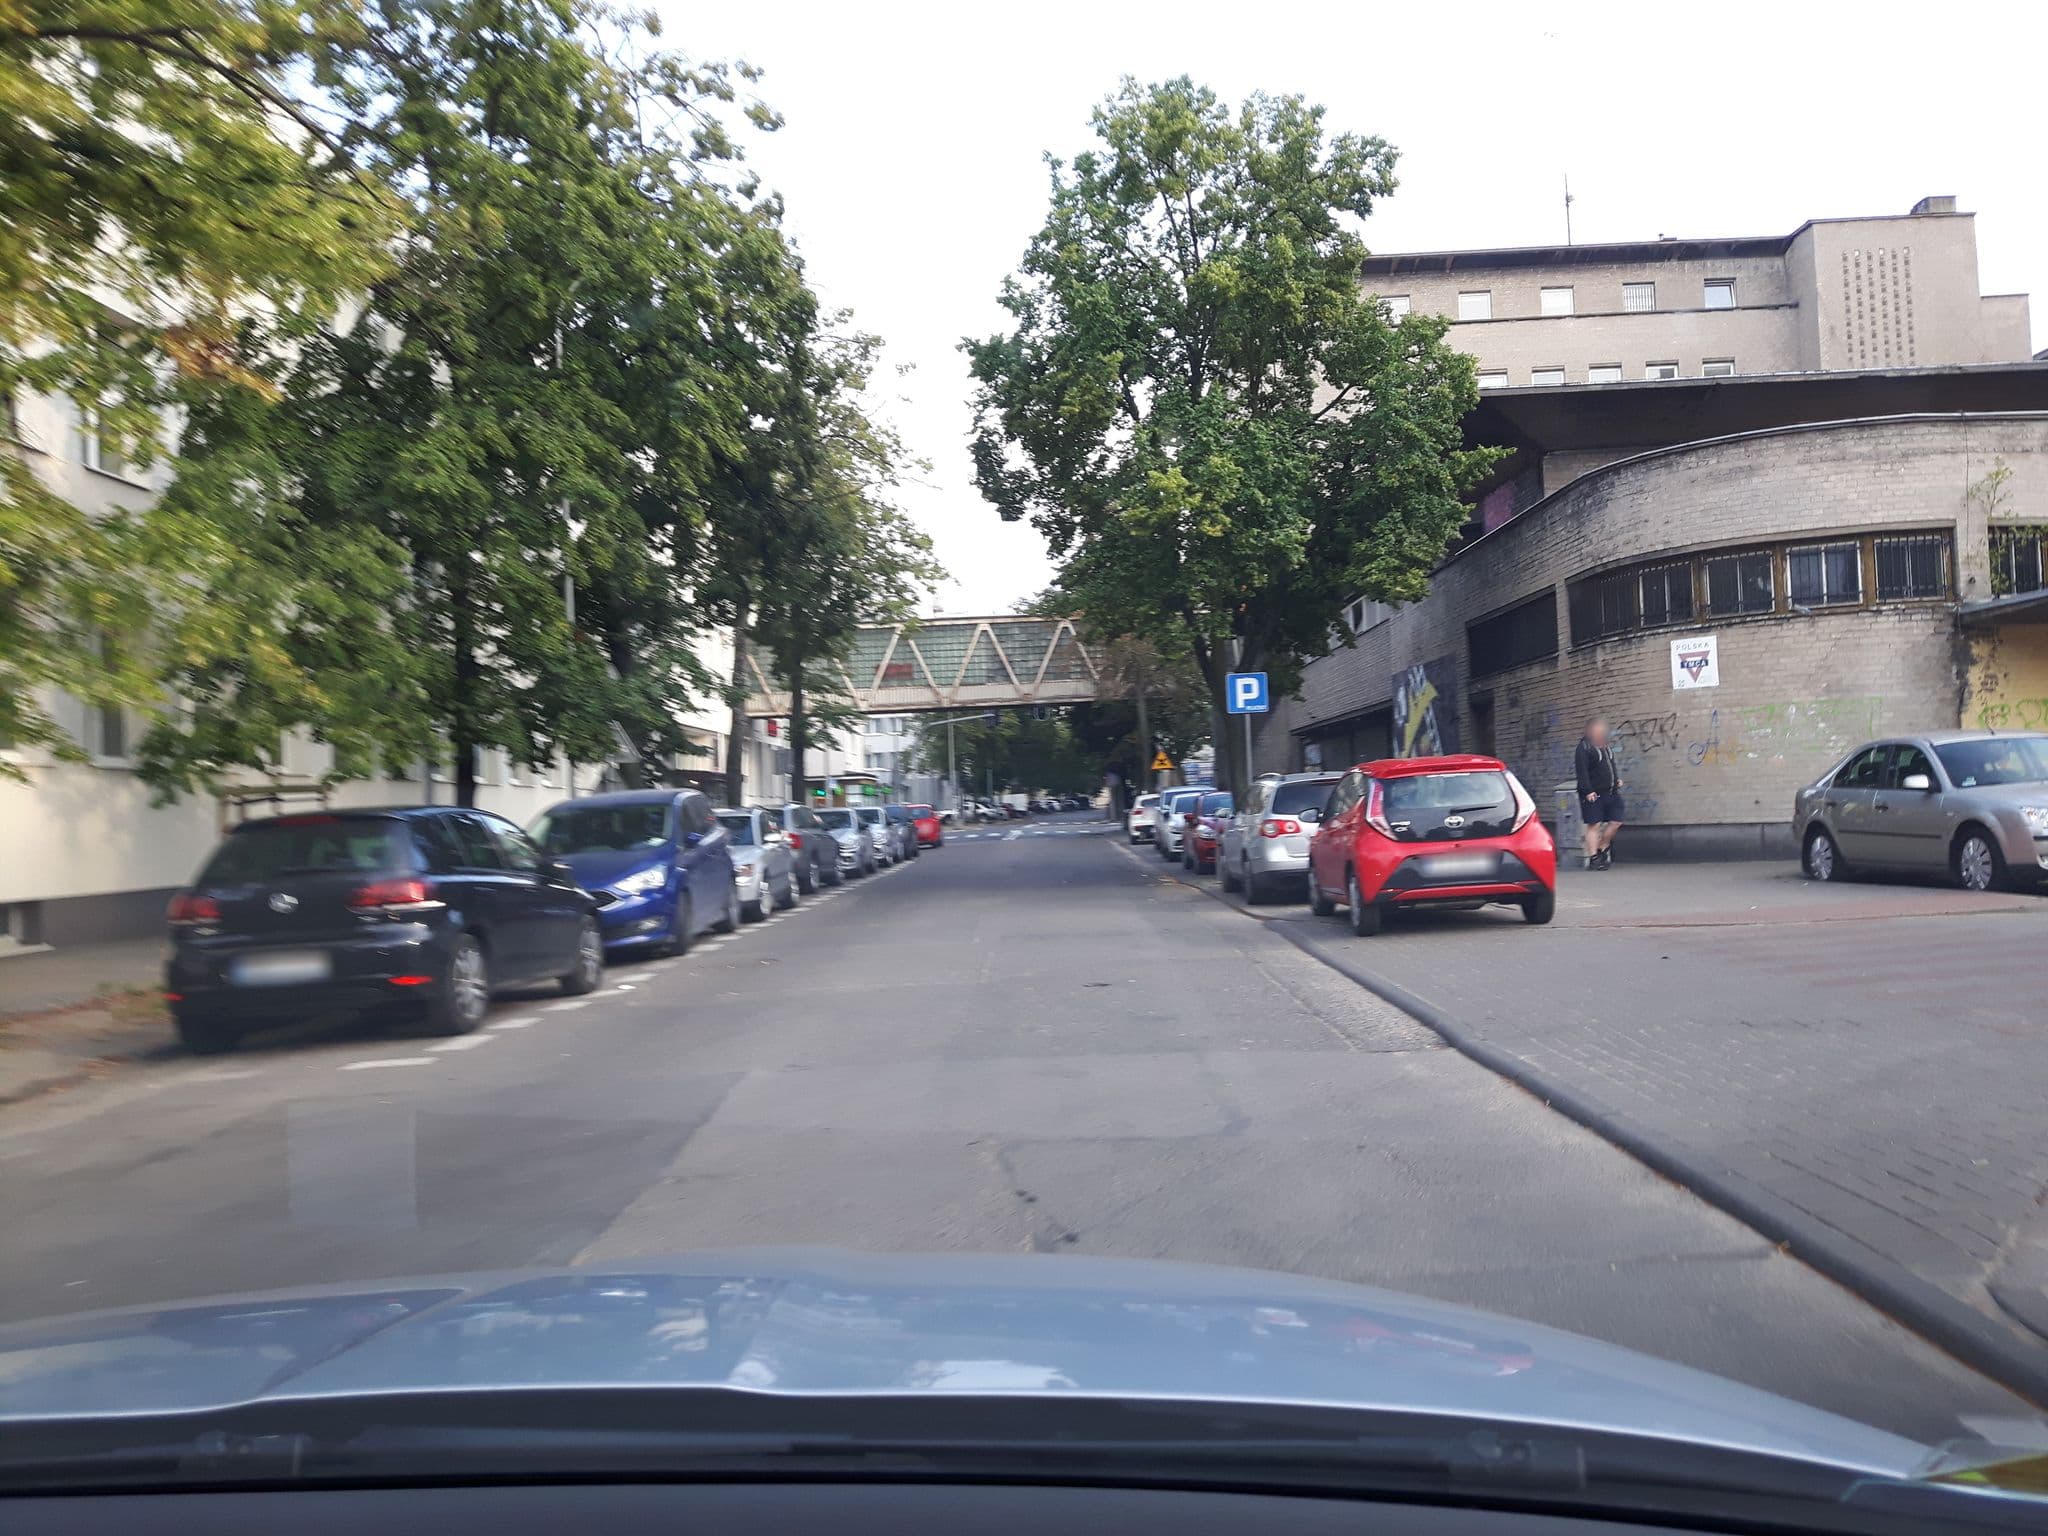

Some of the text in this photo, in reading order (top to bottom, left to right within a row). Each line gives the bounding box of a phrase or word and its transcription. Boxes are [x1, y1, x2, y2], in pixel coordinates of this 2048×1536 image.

[1675, 642, 1710, 650] POLSKA
[1682, 659, 1707, 668] YMCA
[1235, 677, 1260, 709] P
